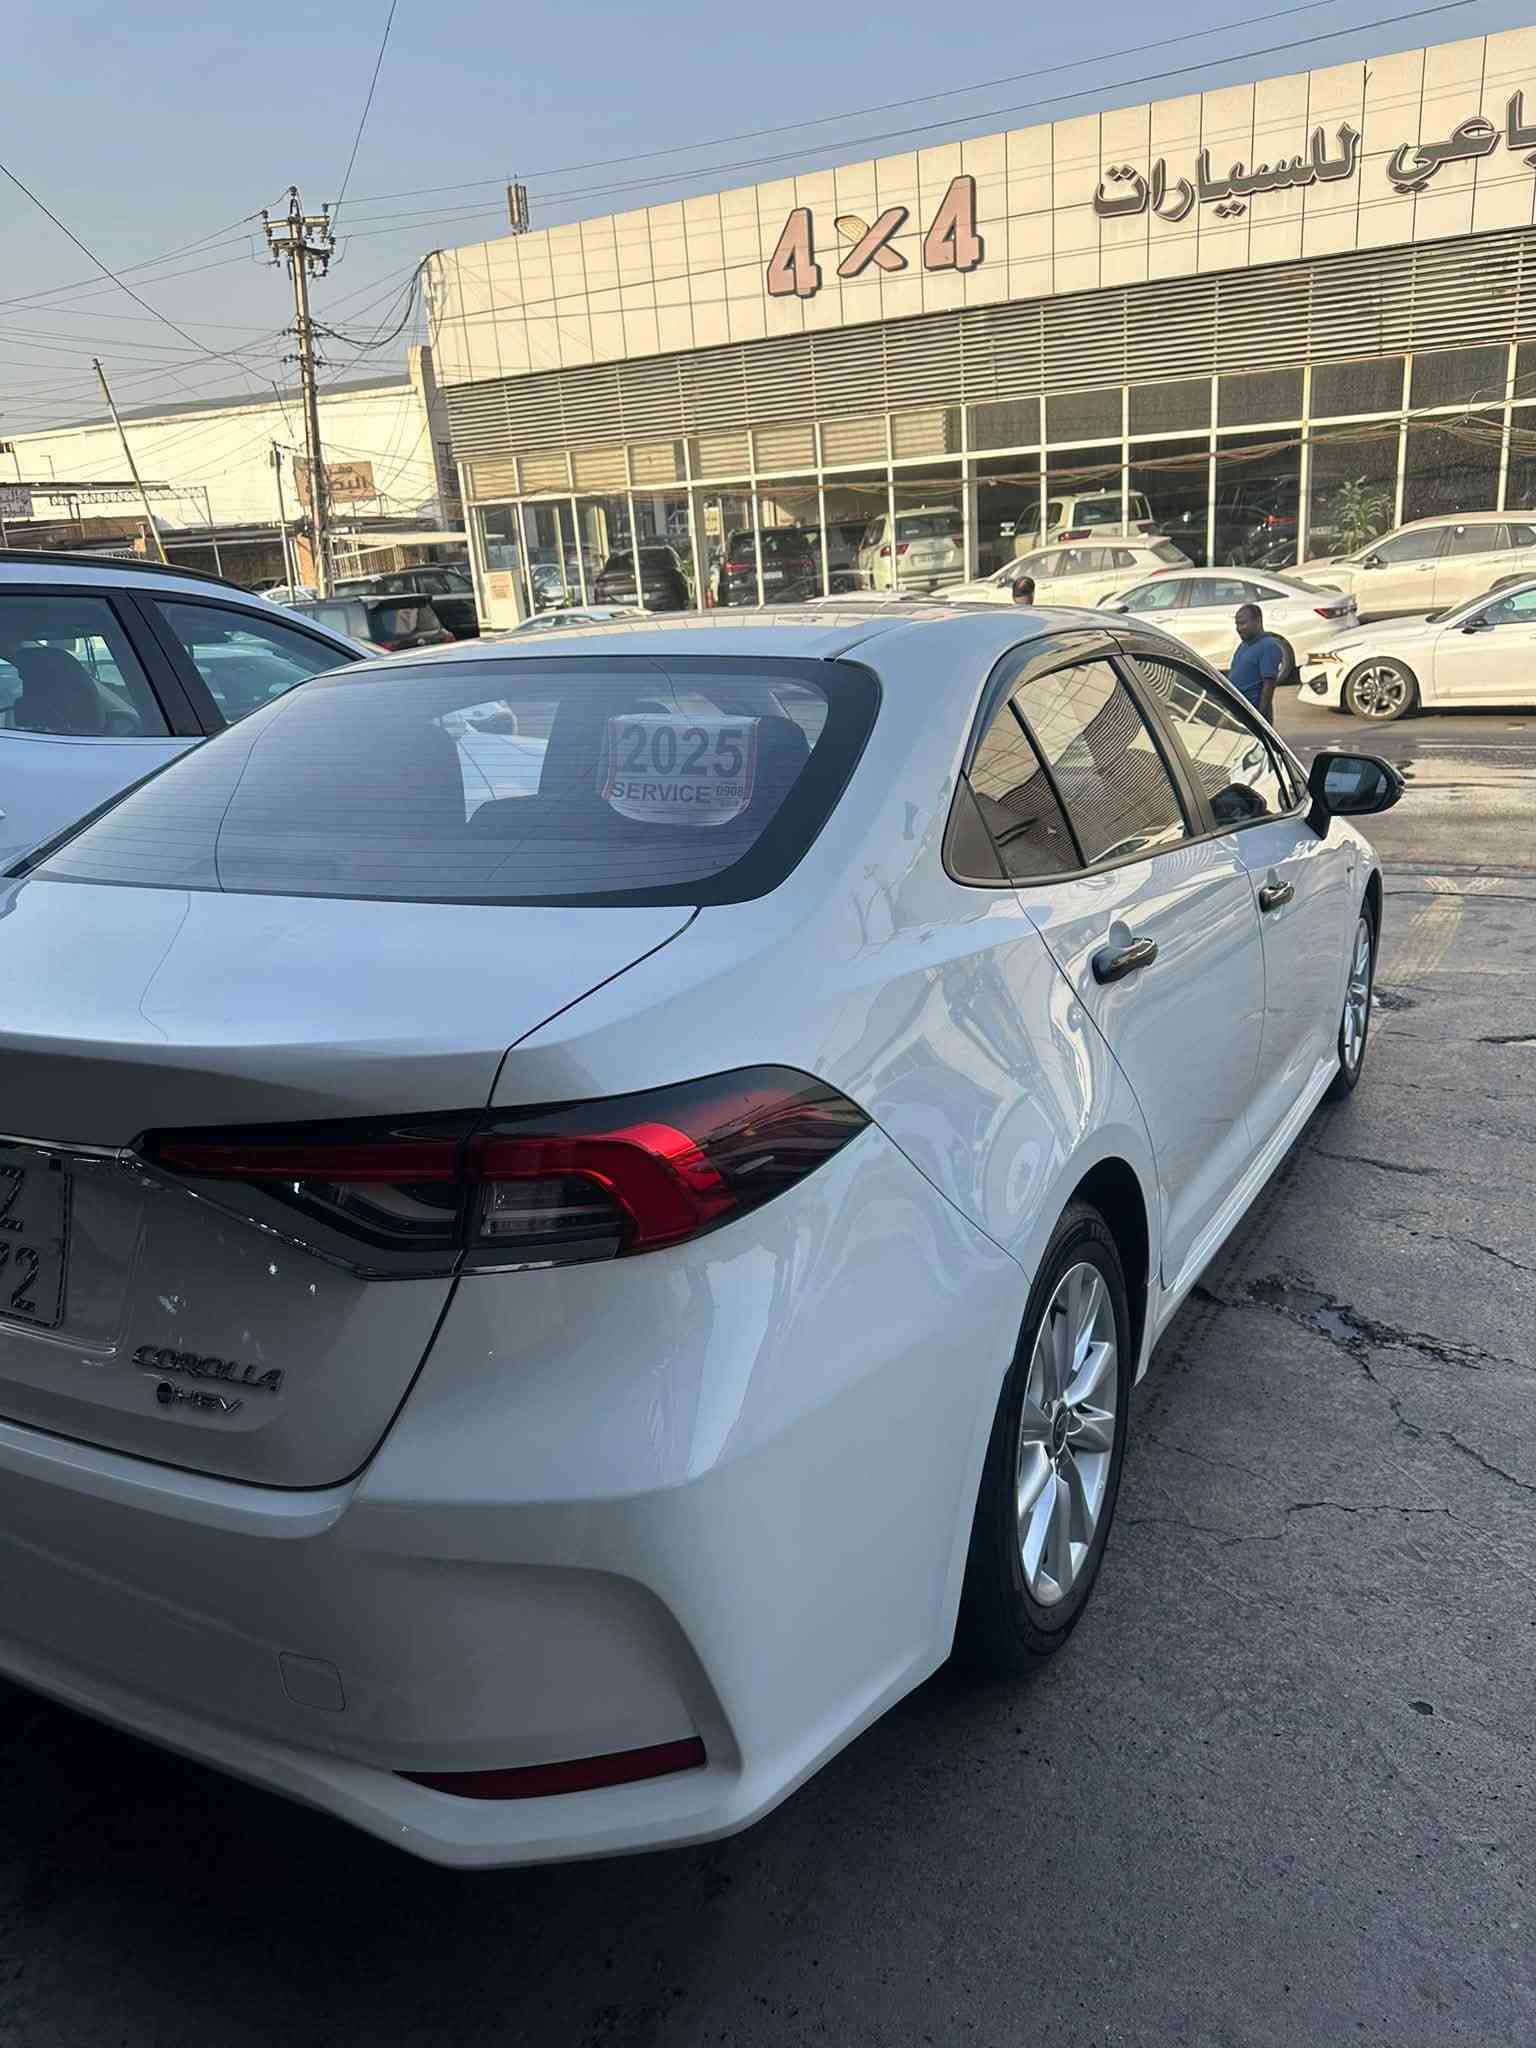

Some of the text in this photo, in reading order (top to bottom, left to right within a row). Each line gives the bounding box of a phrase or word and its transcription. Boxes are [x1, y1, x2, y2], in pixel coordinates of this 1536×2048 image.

[1094, 121, 1360, 222] للسيارات
[620, 724, 744, 777] 2025
[613, 782, 712, 803] SERVICE
[132, 1346, 283, 1391] COROLLA
